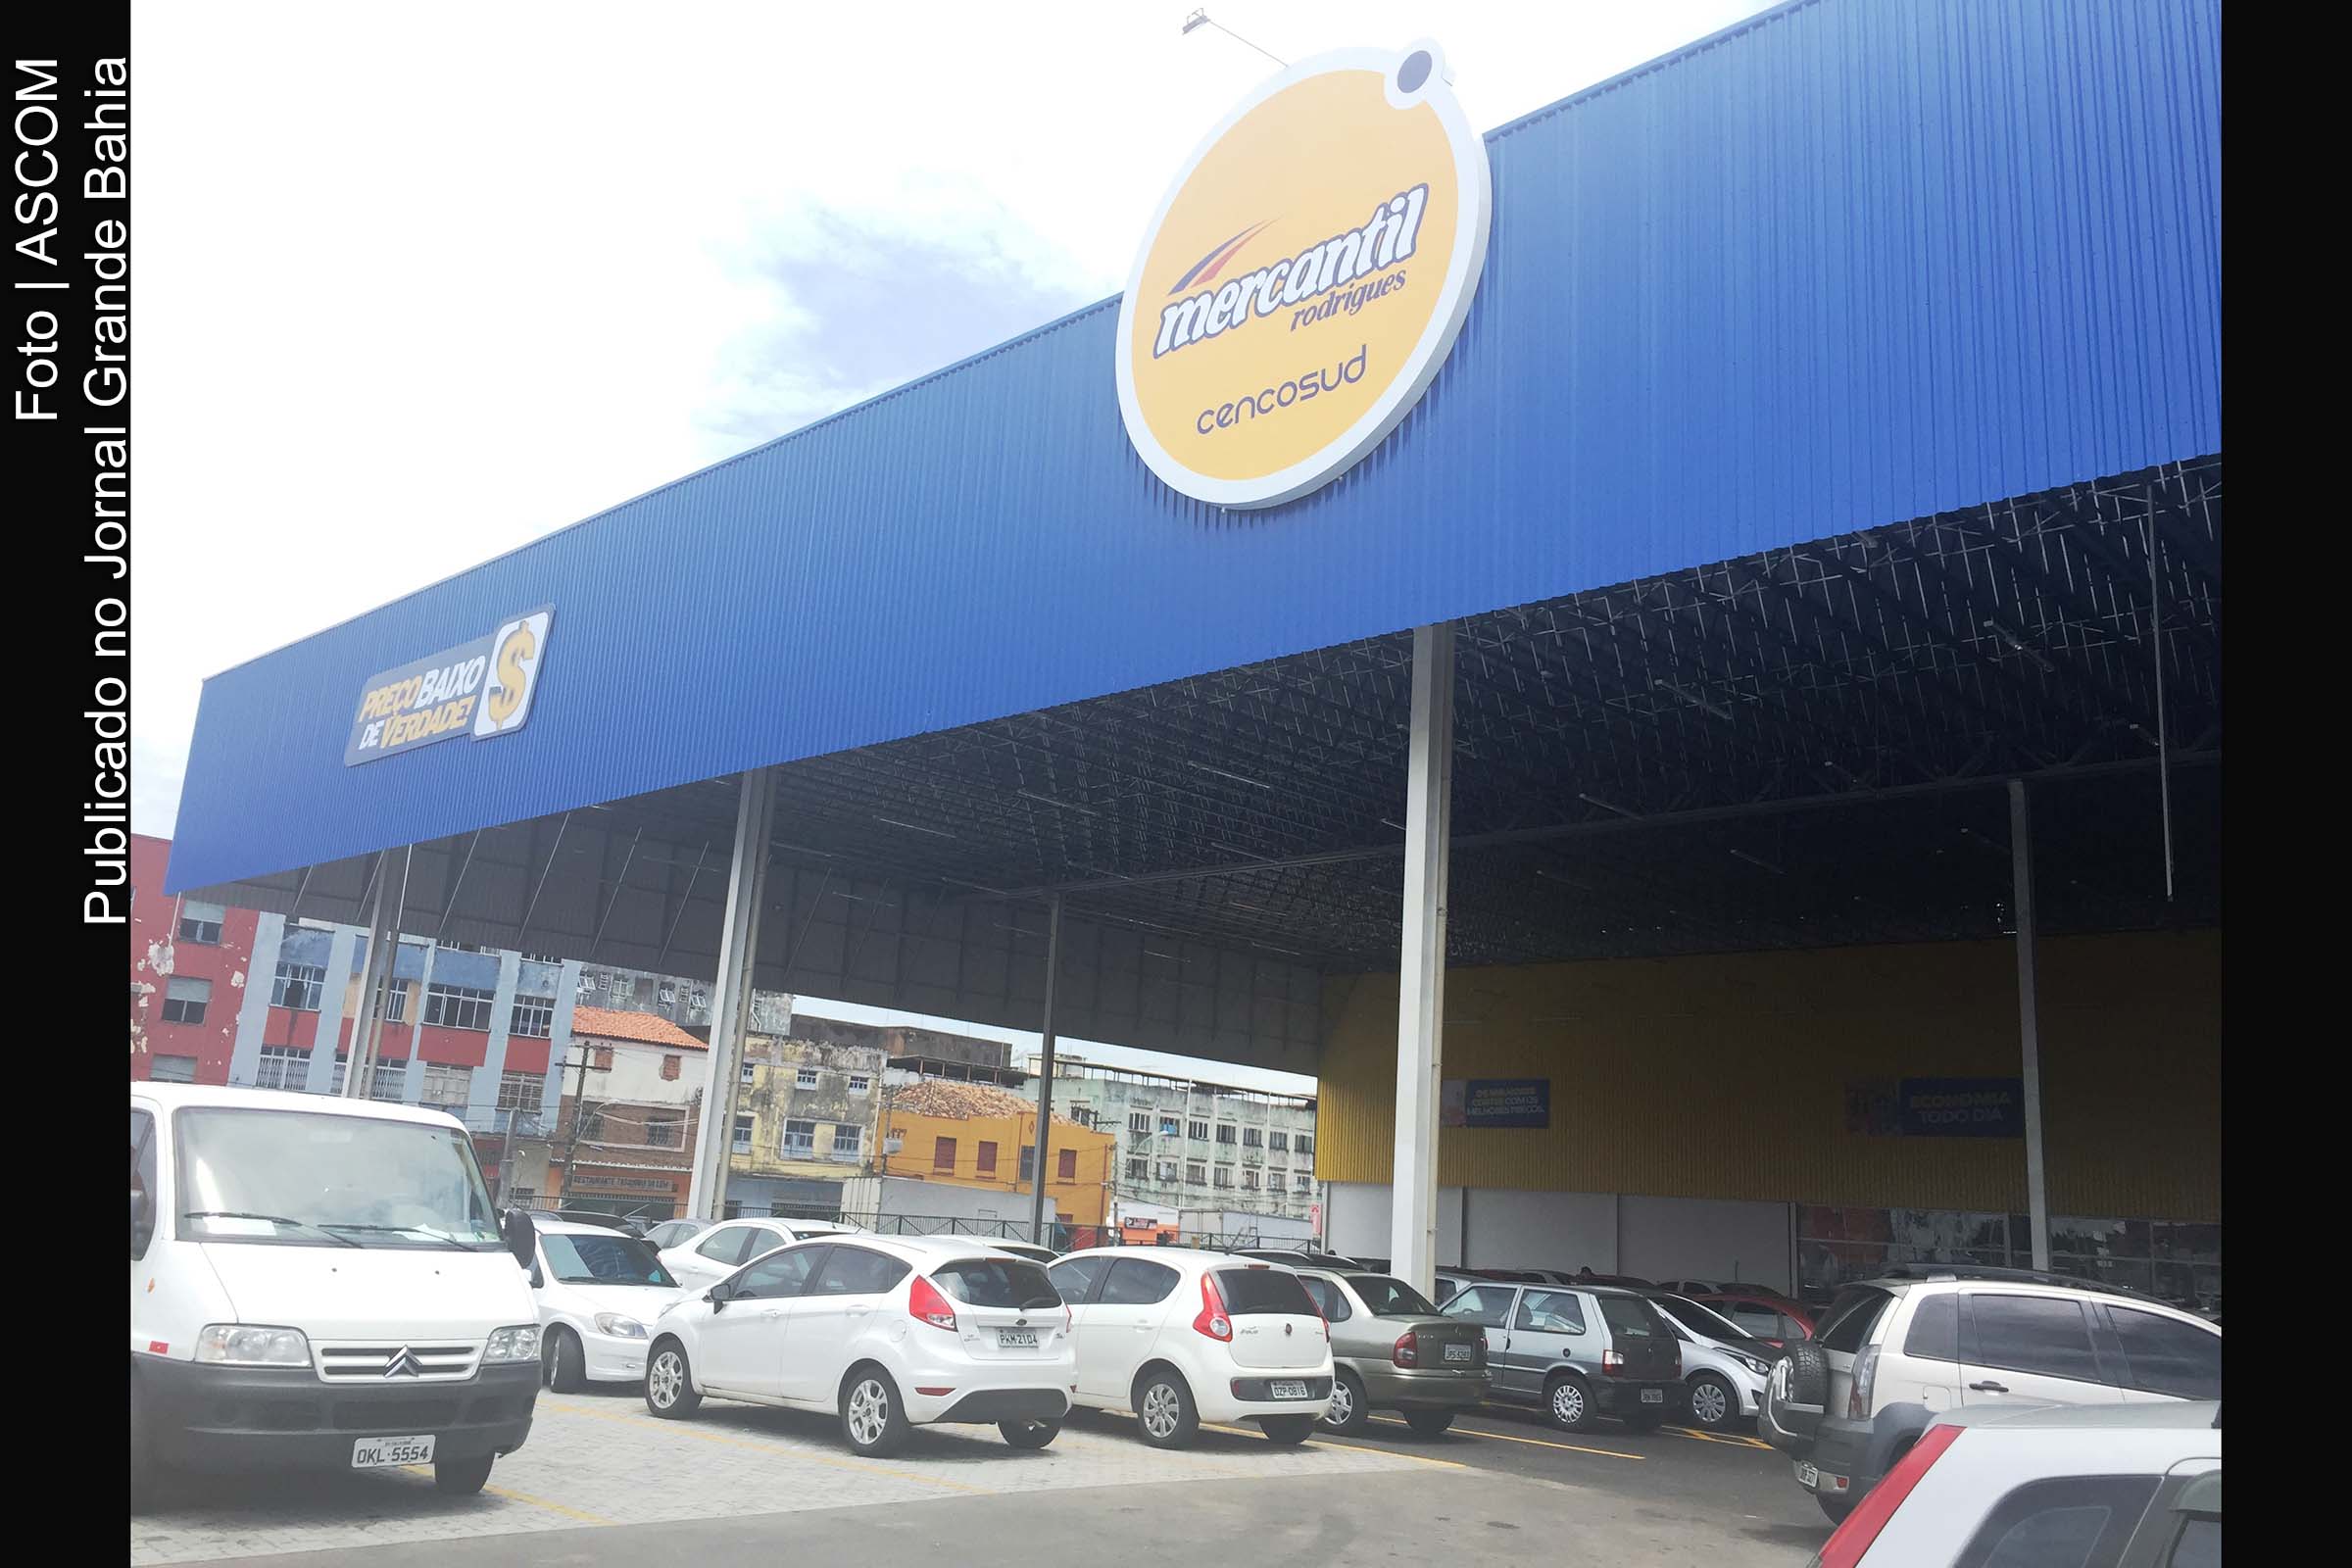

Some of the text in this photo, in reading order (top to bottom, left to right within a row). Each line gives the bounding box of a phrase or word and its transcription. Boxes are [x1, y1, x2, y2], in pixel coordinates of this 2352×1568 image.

[1152, 182, 1429, 360] mercantil
[1290, 270, 1406, 332] rodrigues
[1196, 343, 1367, 435] cencosud
[414, 655, 486, 710] BAIXO
[359, 719, 384, 751] DE
